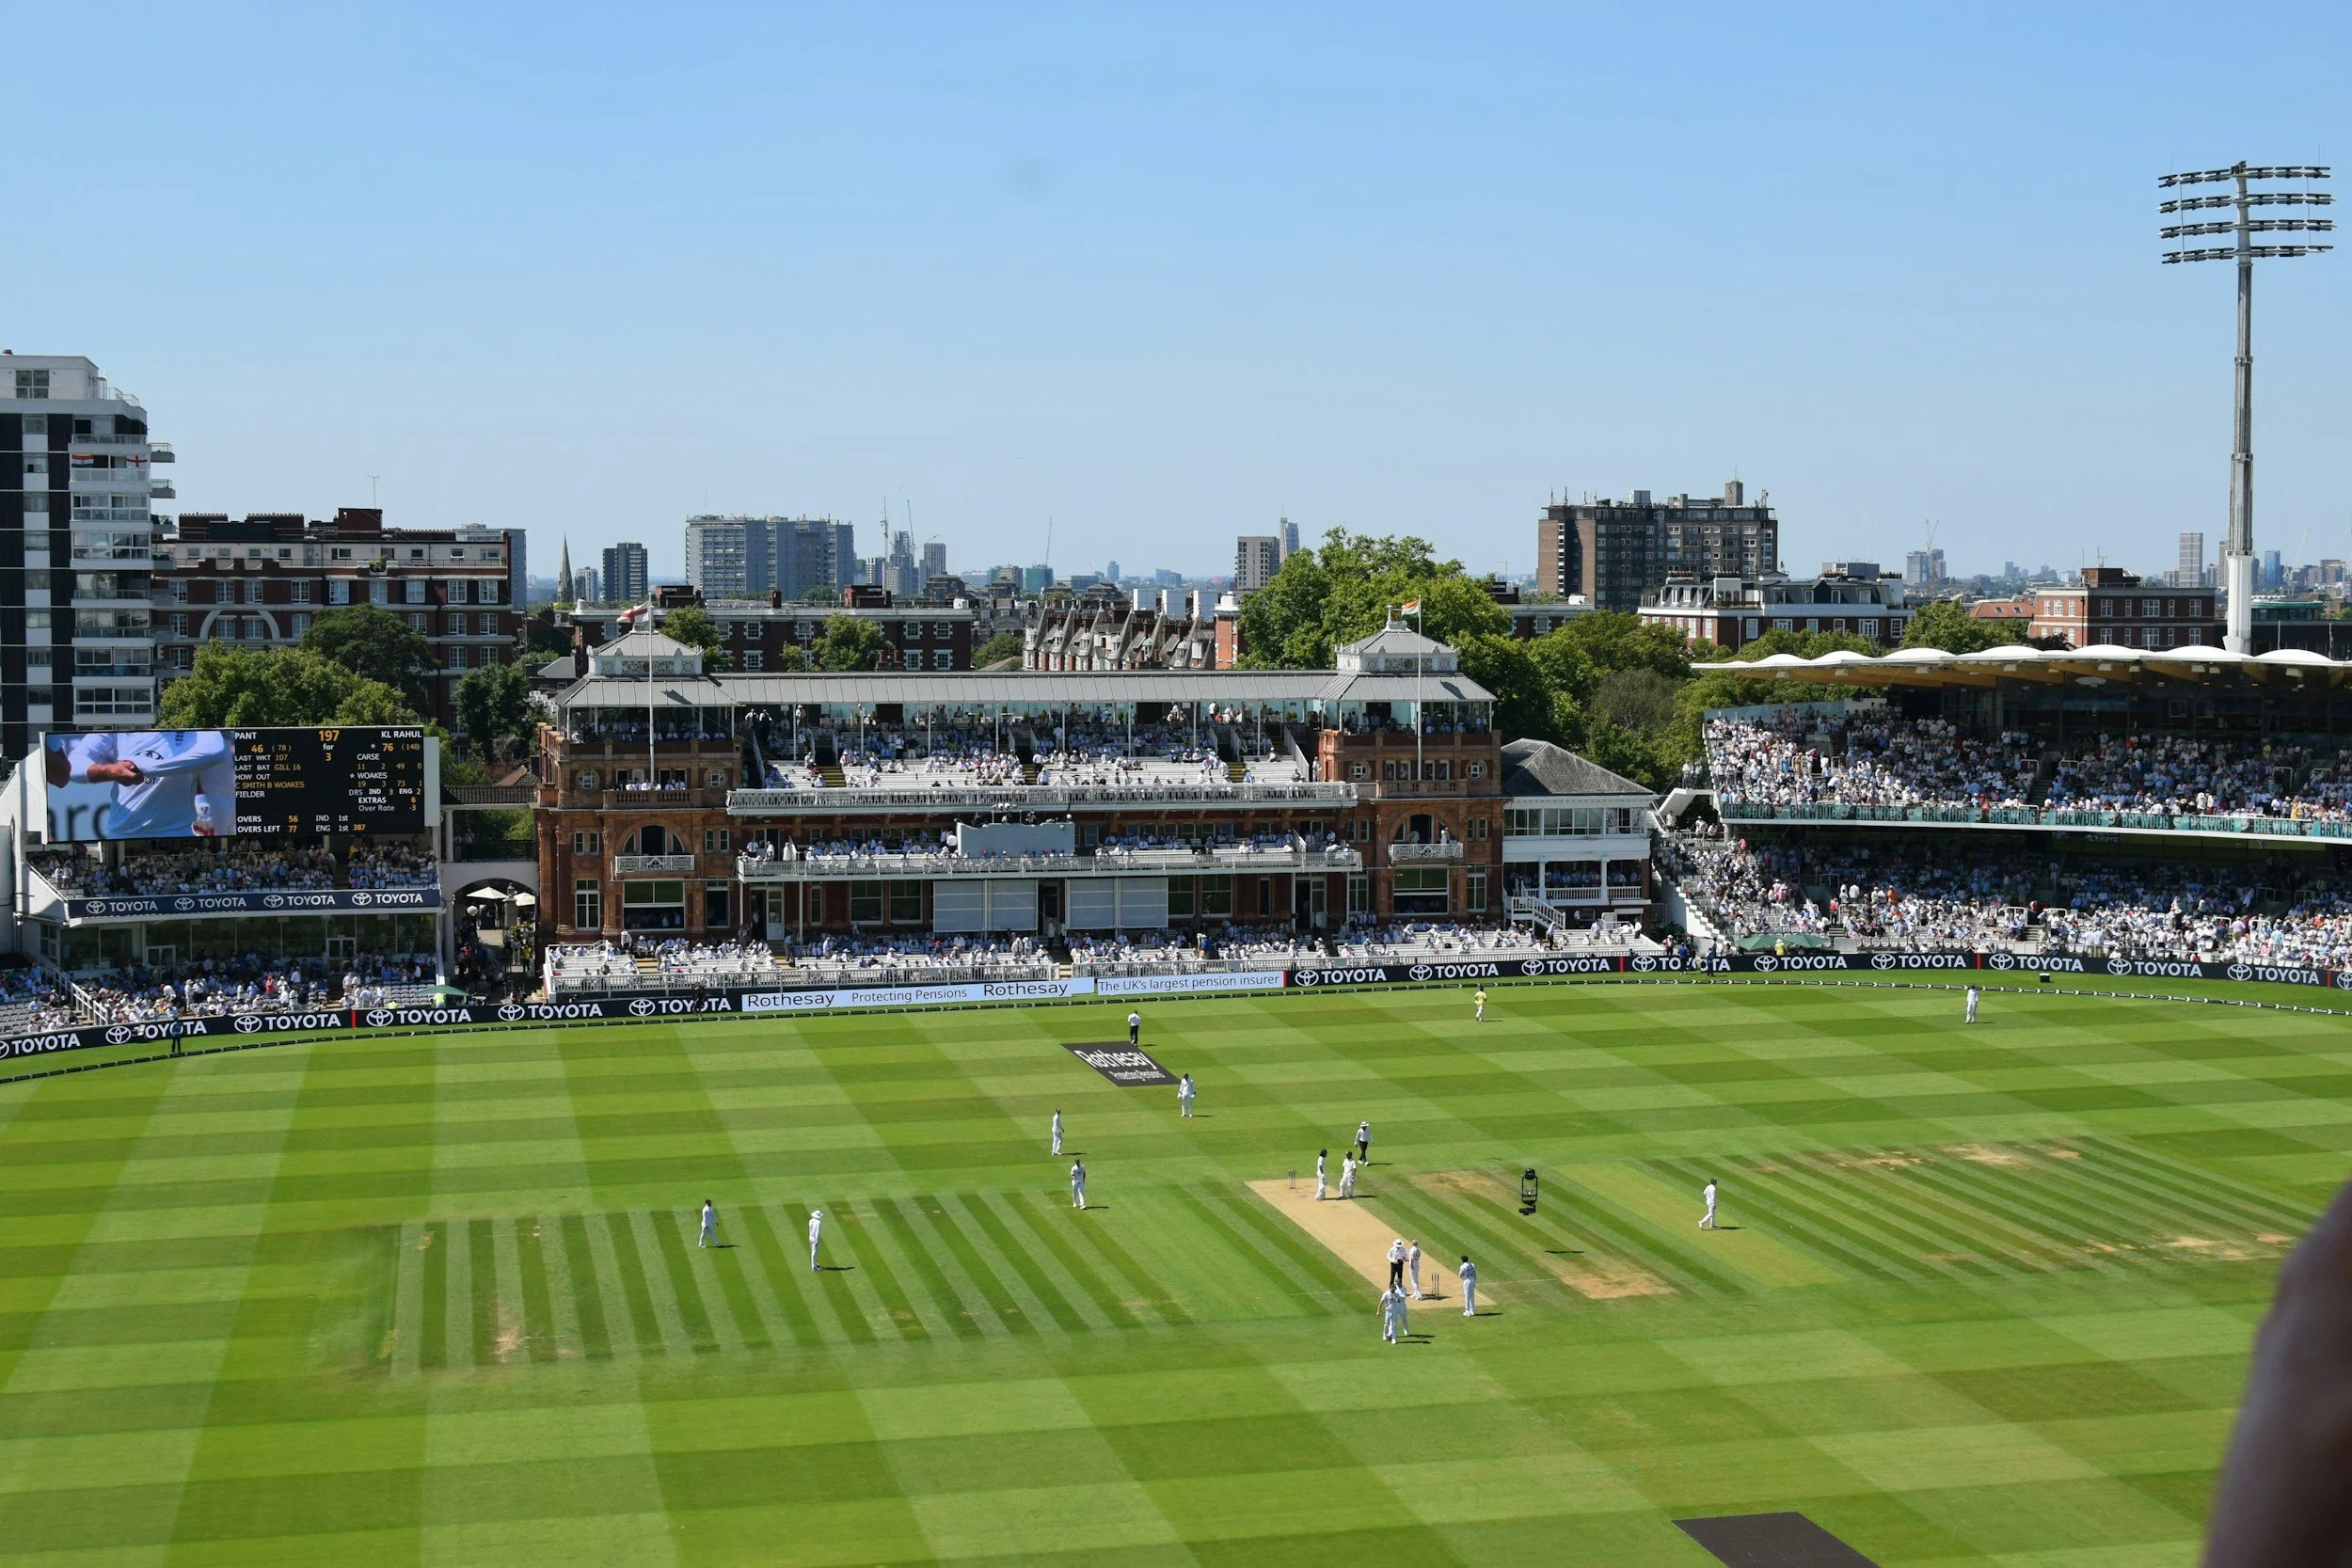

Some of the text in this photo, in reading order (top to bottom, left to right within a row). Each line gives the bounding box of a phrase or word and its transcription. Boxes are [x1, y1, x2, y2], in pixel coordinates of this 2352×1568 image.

[319, 730, 340, 742] 197
[251, 744, 263, 752] 46
[382, 743, 394, 752] 76
[326, 752, 332, 761] 3
[1989, 809, 2036, 824] BREWDOG
[2122, 814, 2169, 829] BREWDOG
[2254, 818, 2300, 835] BREWDOG
[109, 900, 158, 912] TOYOTA
[199, 897, 246, 909] TOYOTA
[287, 895, 336, 906] TOYOTA
[375, 893, 423, 904] TOYOTA
[1547, 958, 1611, 974] TOYOTA
[1781, 956, 1848, 970] TOYOTA
[1898, 954, 1966, 968] TOYOTA
[2017, 956, 2084, 972] TOYOTA
[2135, 960, 2202, 977] TOYOTA
[1321, 968, 1387, 984] TOYOTA
[1435, 963, 1499, 978] TOYOTA
[2255, 967, 2320, 985] TOYOTA
[983, 982, 1069, 997] Rothesay
[1099, 974, 1280, 991] The UK's largest pension insurer
[748, 992, 835, 1007] Rothesay
[851, 989, 967, 1004] Protecting Pensions
[396, 1008, 472, 1024] TOYOTA
[528, 1003, 603, 1020] TOYOTA
[266, 1013, 342, 1030] TOYOTA
[11, 1033, 81, 1054] TOYOTA
[1073, 1049, 1158, 1070] Rothesay
